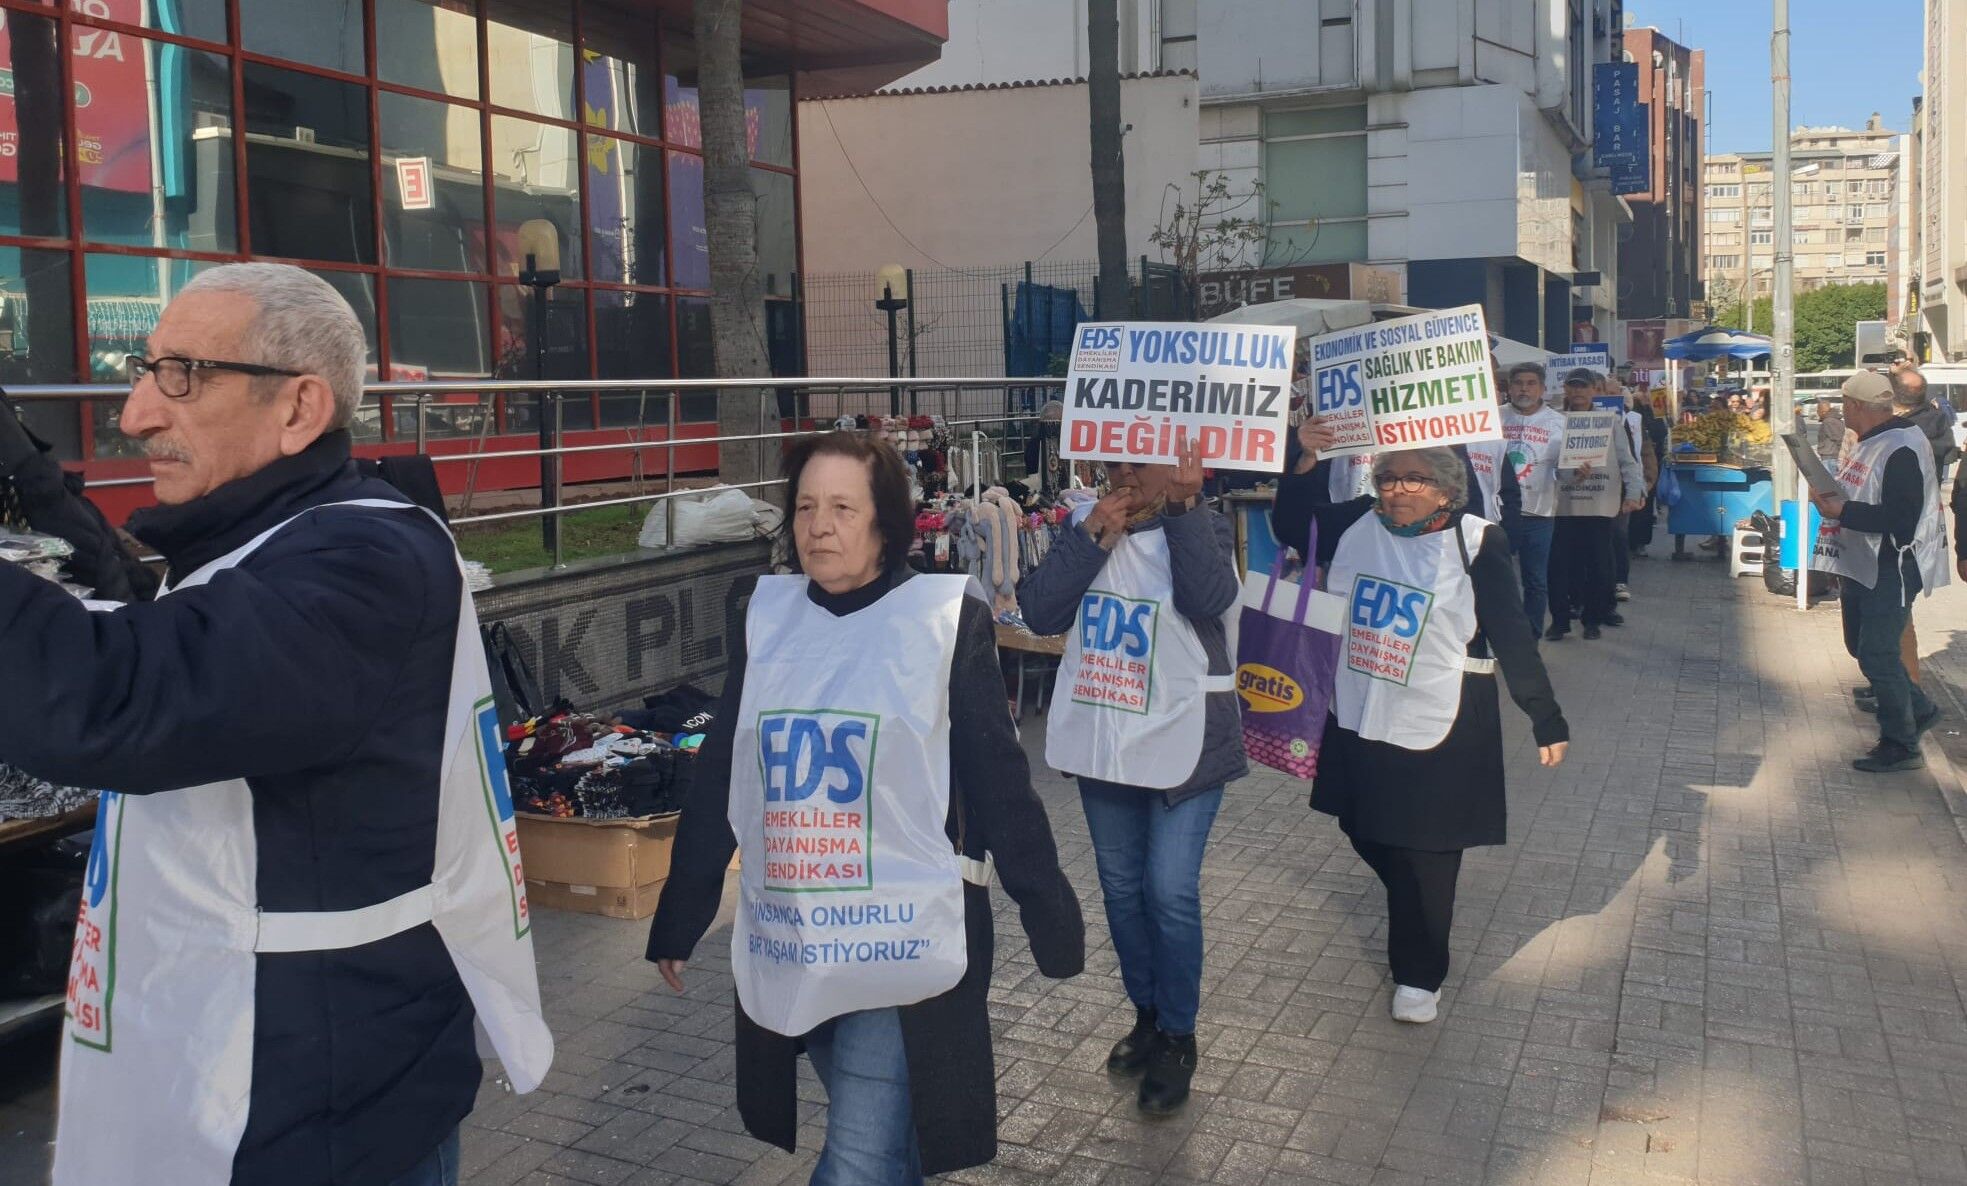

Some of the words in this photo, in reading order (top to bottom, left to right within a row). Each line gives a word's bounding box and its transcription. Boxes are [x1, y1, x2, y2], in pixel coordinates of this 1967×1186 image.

[1200, 275, 1296, 305] BÜFE
[1080, 327, 1121, 350] EDS
[1129, 330, 1288, 370] YOKSULLUK
[1315, 332, 1362, 362] EKONOMİK
[1365, 331, 1377, 350] VE
[1380, 324, 1422, 347] SOSYAL
[1425, 312, 1480, 339] GÜVENCE
[1365, 351, 1414, 380] SAĞLIK
[1416, 347, 1434, 369] VE
[1436, 338, 1485, 365] BAKIM
[1074, 375, 1282, 417] KADERİMİZ
[1318, 364, 1362, 411] EDS
[1371, 365, 1488, 415] HİZMETİ
[1328, 409, 1364, 421] EKLİLER
[1374, 410, 1492, 446] İSTİYORUZ
[1069, 414, 1277, 463] DEĞİLDİR
[1352, 578, 1427, 638] EDS
[1082, 594, 1152, 658] EDS
[1351, 628, 1411, 653] EMEKLİLER
[1077, 669, 1145, 691] AYANIŞMA
[1239, 669, 1295, 701] gratis
[682, 710, 715, 730] ICON
[761, 718, 867, 804] EDS
[765, 807, 862, 829] EMEKLİLER
[766, 837, 862, 857] DAYANIŞMA
[767, 861, 863, 880] SENDİKASI
[811, 903, 915, 927] ONURLU
[763, 937, 798, 965] YAŞAM
